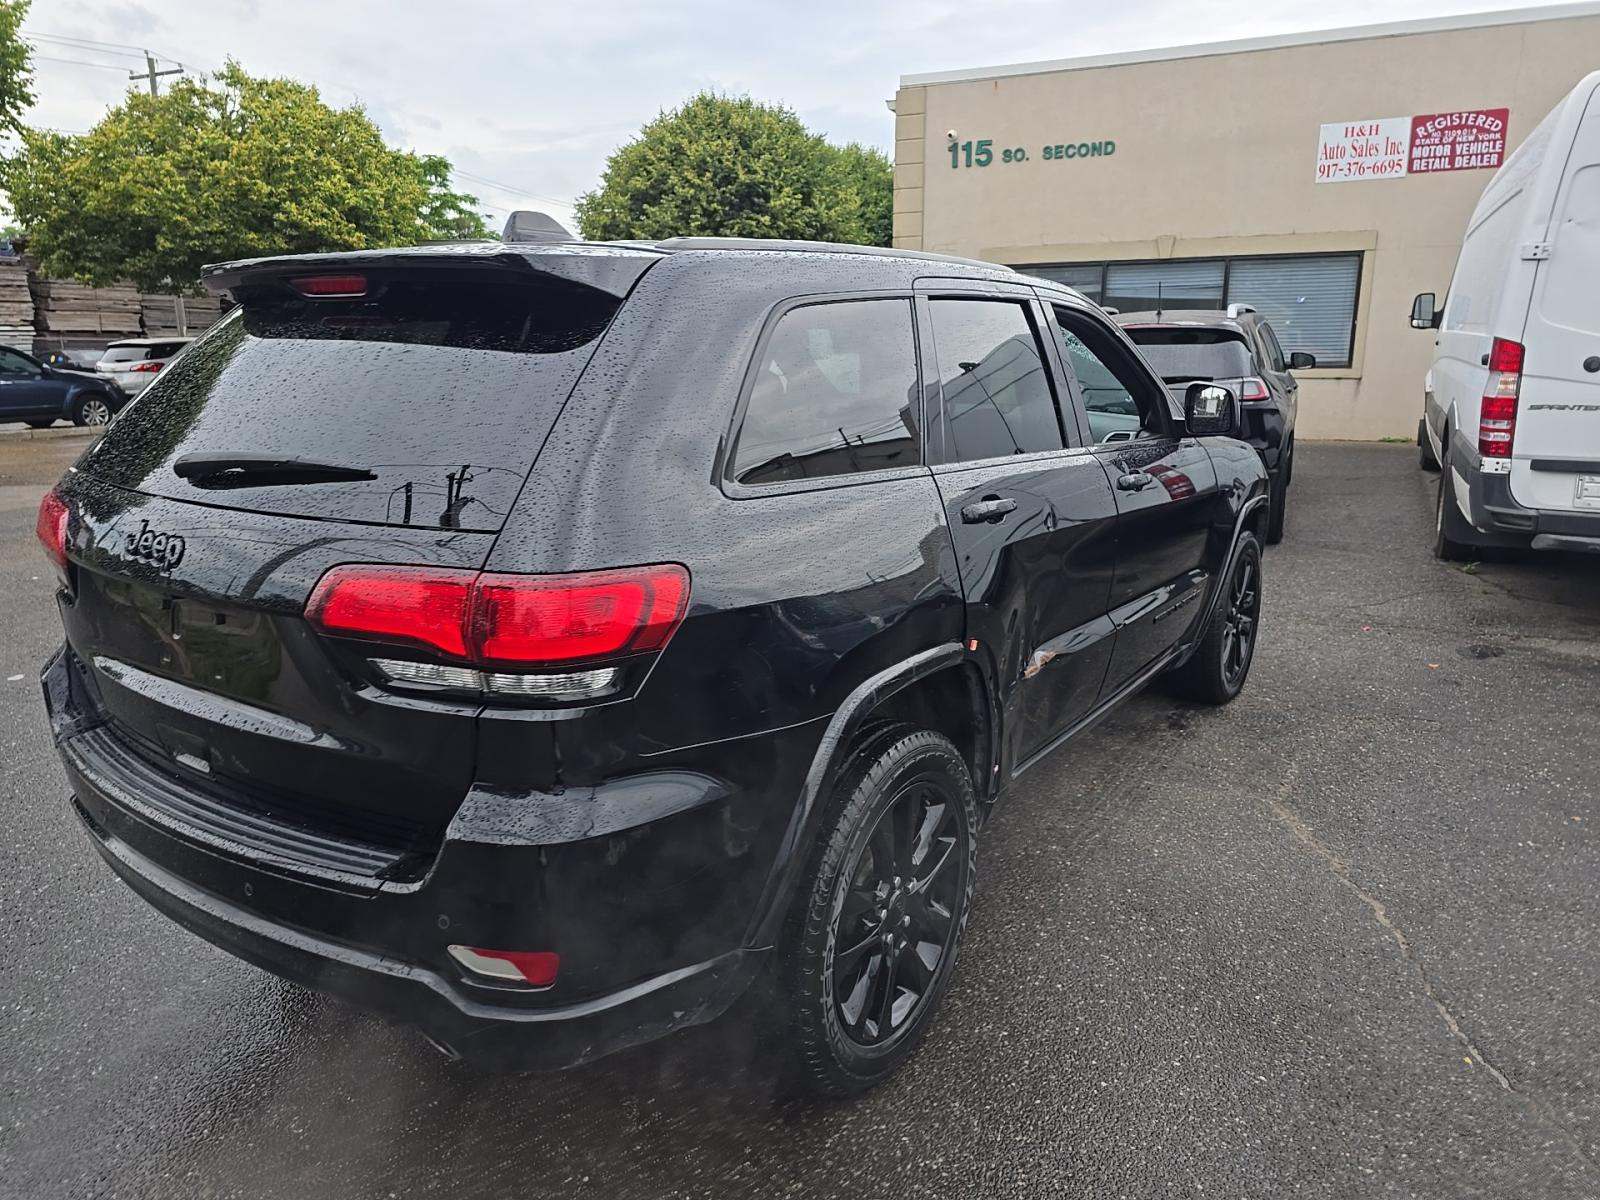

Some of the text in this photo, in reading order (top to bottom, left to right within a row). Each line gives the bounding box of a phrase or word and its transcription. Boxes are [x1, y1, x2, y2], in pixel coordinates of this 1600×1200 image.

[1344, 124, 1379, 138] H&H
[1416, 113, 1502, 138] REGISTERED
[1320, 136, 1405, 161] Auto Sales Inc.
[1412, 140, 1503, 158] MOTOR VEHICLE
[1415, 137, 1440, 145] STATE
[1456, 134, 1475, 142] NEW
[1477, 132, 1501, 140] YORK
[948, 139, 1116, 169] 115 SO. SECOND
[1413, 154, 1498, 171] RETAIL DEALER
[1318, 158, 1403, 179] 917-376-6695
[126, 519, 185, 573] Jeep
